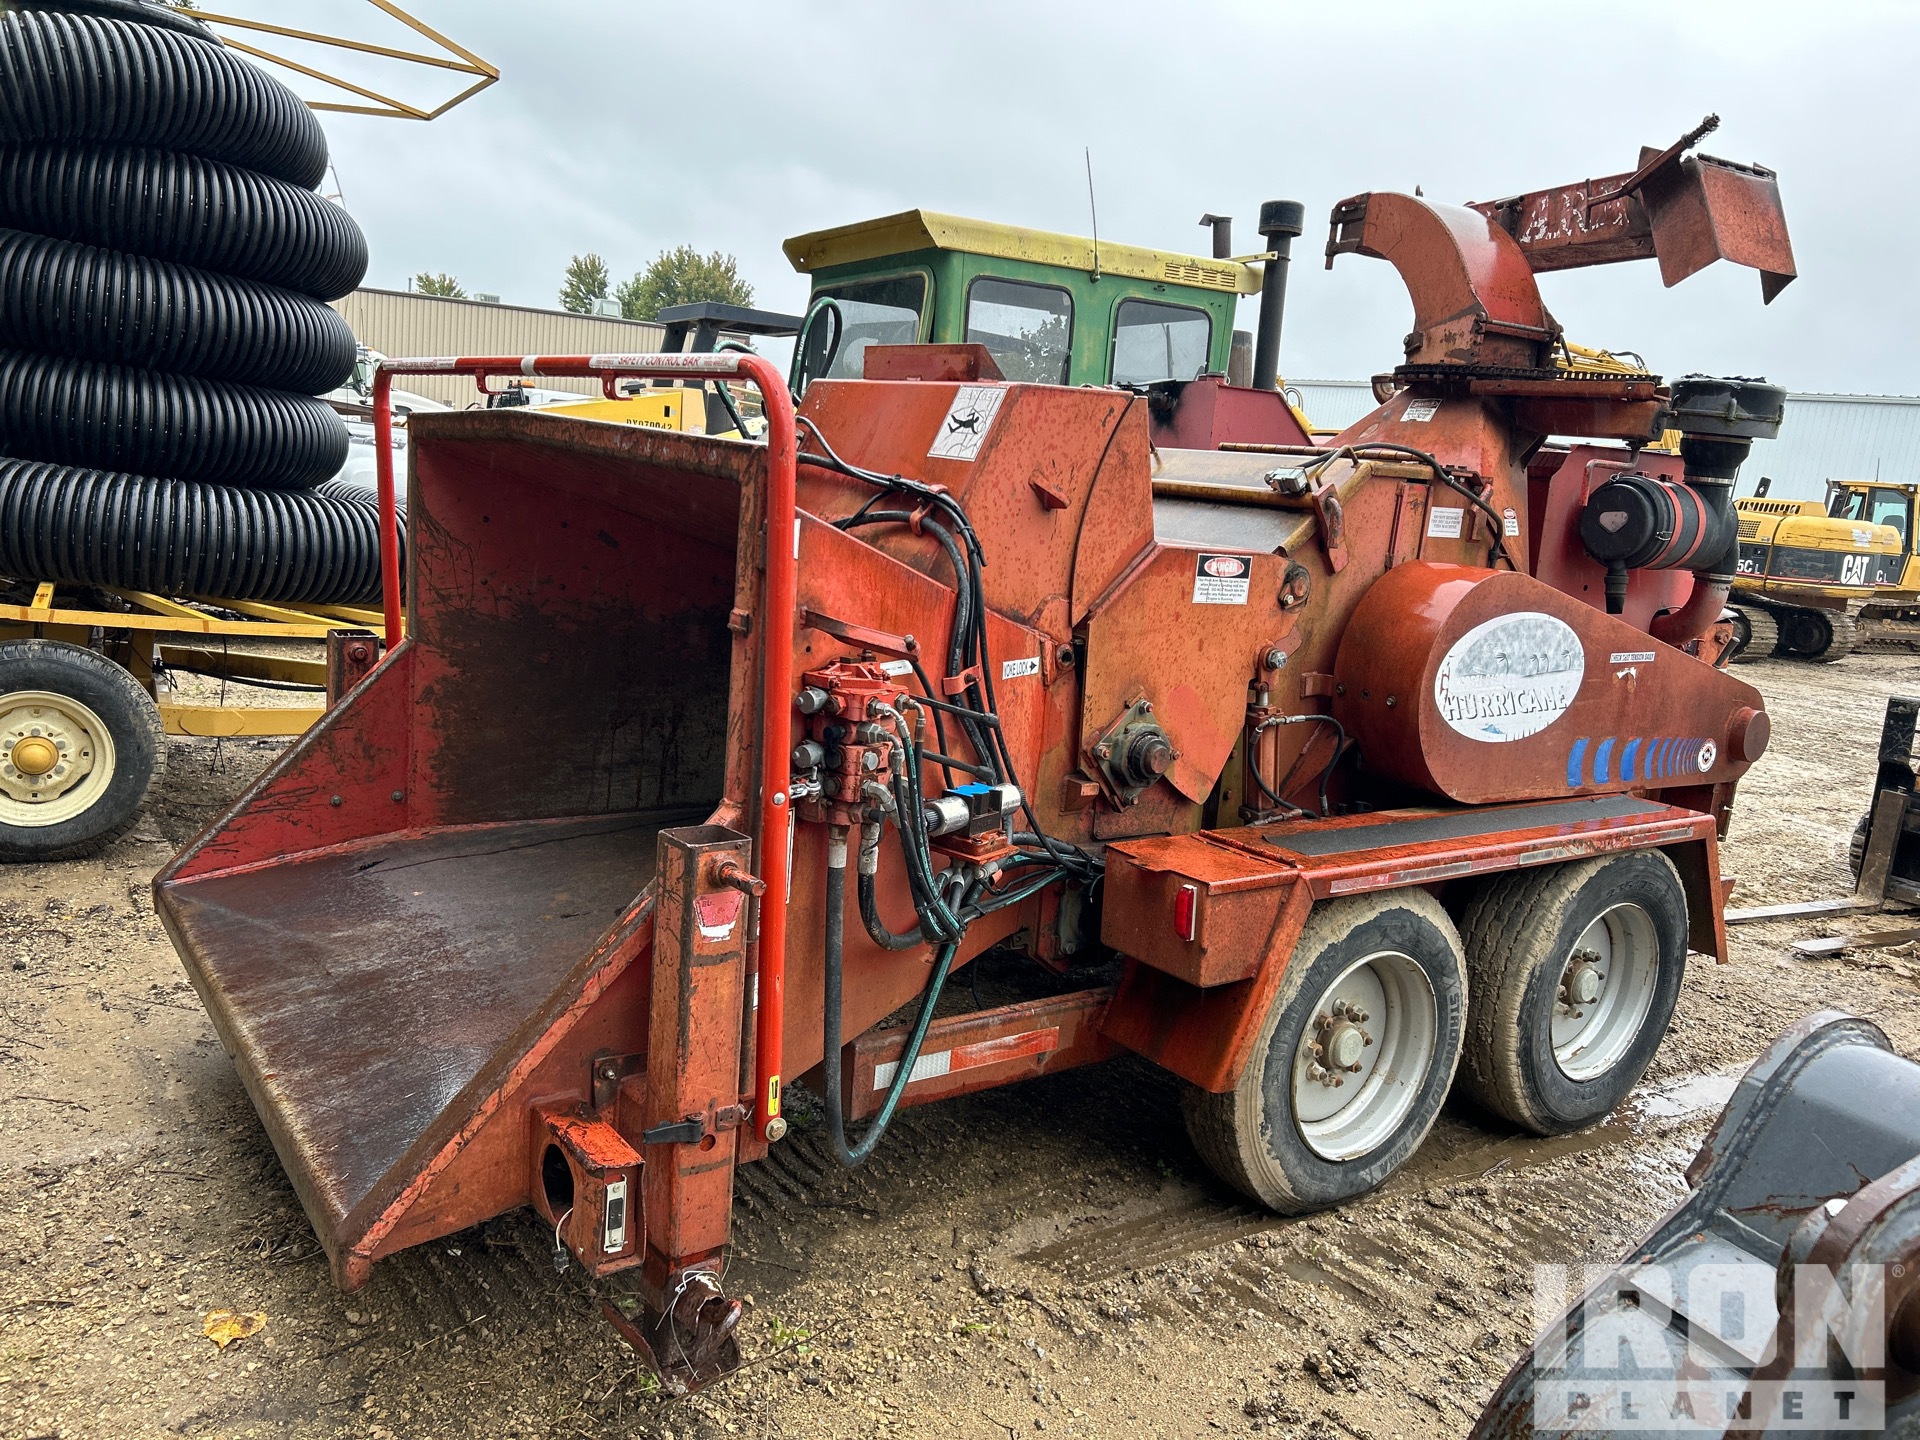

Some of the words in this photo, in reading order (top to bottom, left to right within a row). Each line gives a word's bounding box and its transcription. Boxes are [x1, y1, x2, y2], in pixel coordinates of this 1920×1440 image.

[618, 356, 644, 366] SAFETY
[645, 356, 681, 367] CONTROL
[683, 356, 700, 367] BAR
[1840, 554, 1871, 586] CAT
[1004, 662, 1017, 678] YOKE
[1446, 685, 1569, 722] HURRICANE
